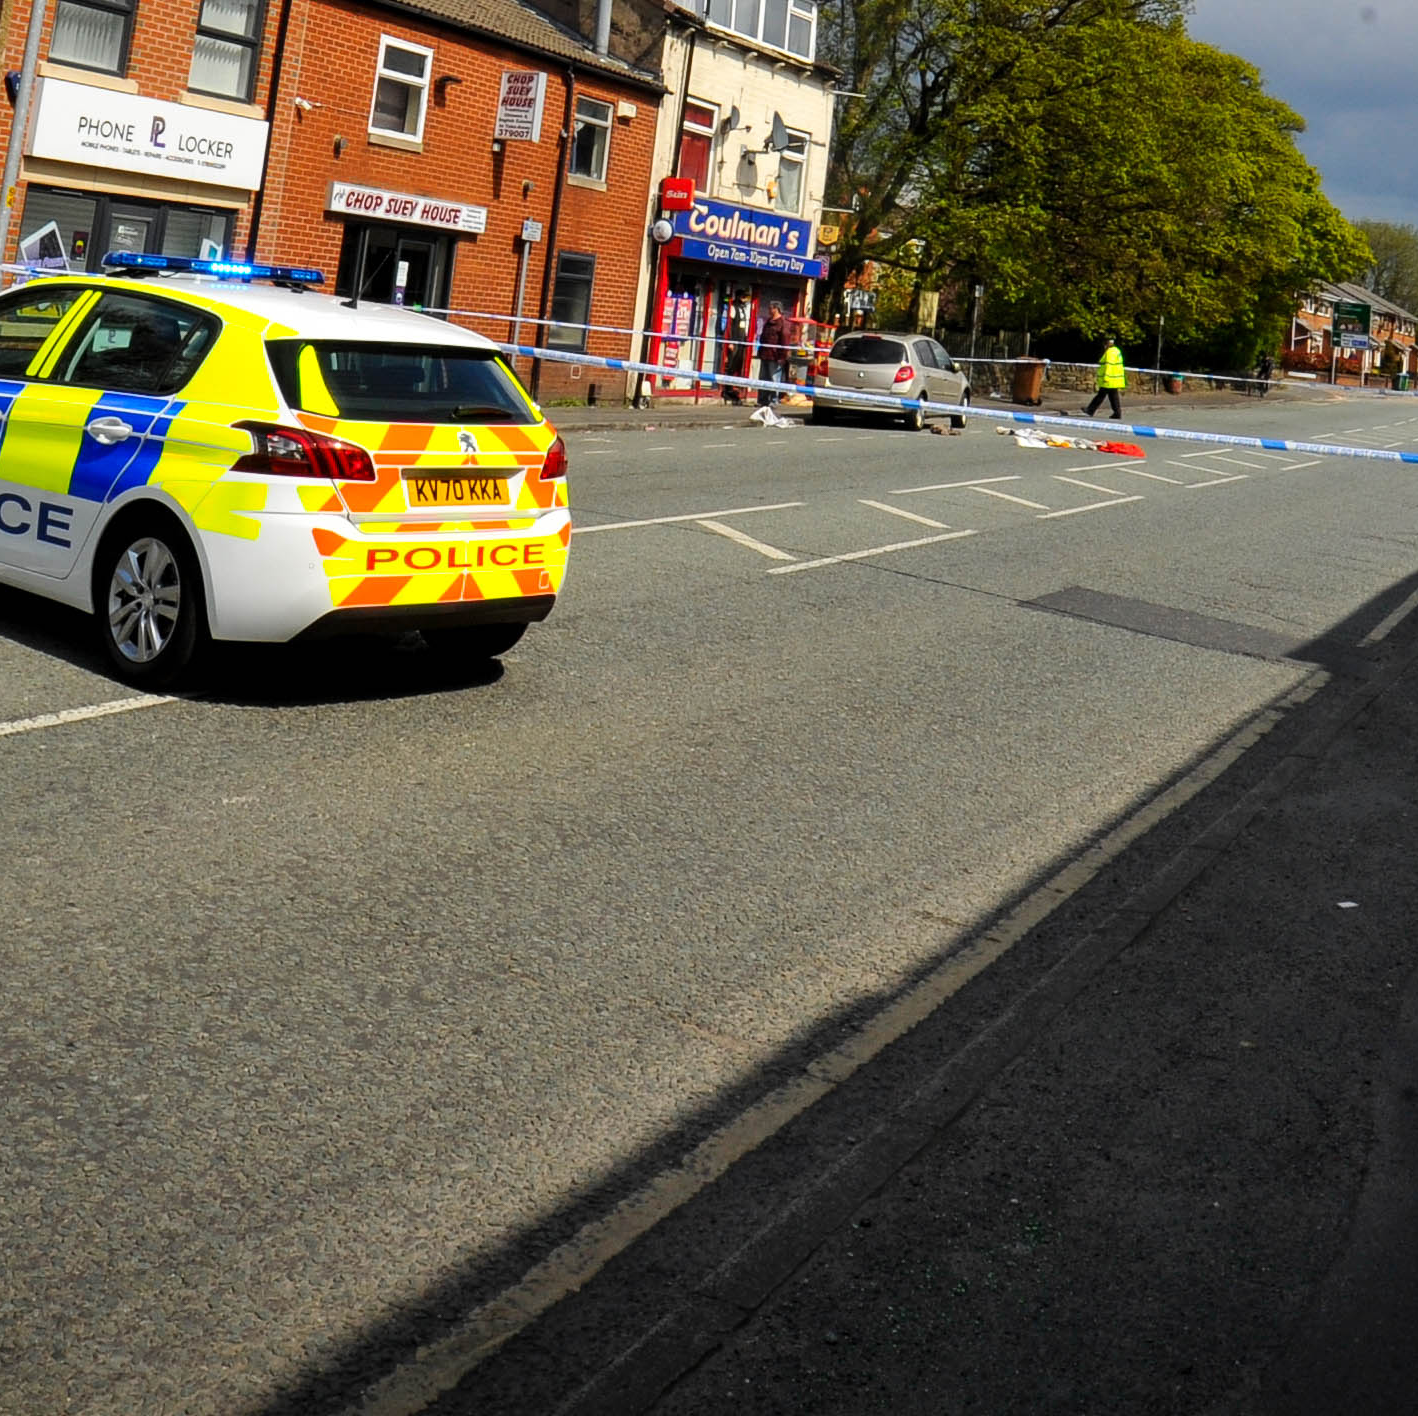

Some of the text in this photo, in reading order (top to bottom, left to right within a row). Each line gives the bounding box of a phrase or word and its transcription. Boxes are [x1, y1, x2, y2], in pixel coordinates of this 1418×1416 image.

[506, 85, 533, 96] SUEY
[507, 74, 535, 85] CHOP
[501, 96, 535, 109] HOUSE
[78, 116, 136, 142] PHONE
[178, 133, 234, 160] LOCKER
[346, 191, 383, 211] CHOP
[385, 197, 418, 217] SUEY
[421, 204, 462, 225] HOUSE
[689, 204, 800, 251] Coulman's
[707, 244, 729, 261] Open
[769, 253, 790, 271] Every
[790, 257, 804, 274] Day
[416, 479, 502, 502] KV70 KKA
[366, 543, 545, 572] POLICE
